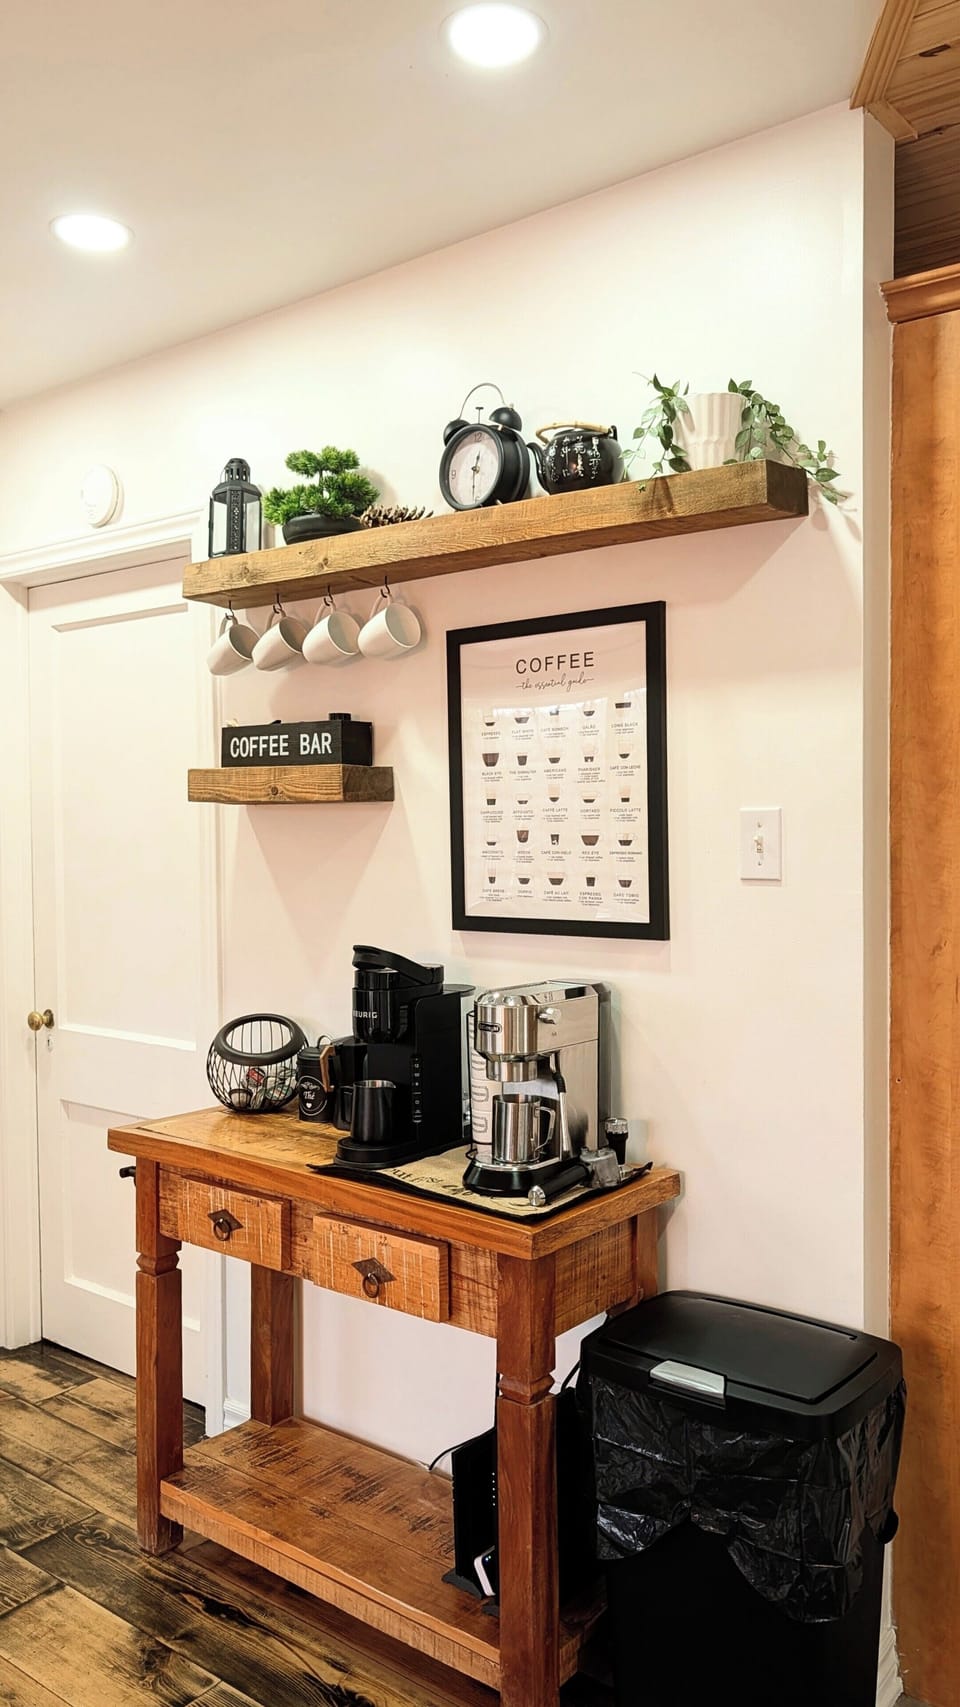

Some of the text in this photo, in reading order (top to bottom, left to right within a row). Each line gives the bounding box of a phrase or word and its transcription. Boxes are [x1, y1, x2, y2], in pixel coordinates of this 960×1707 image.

[516, 651, 594, 674] COFFEE
[230, 733, 332, 758] COFFEE BAR
